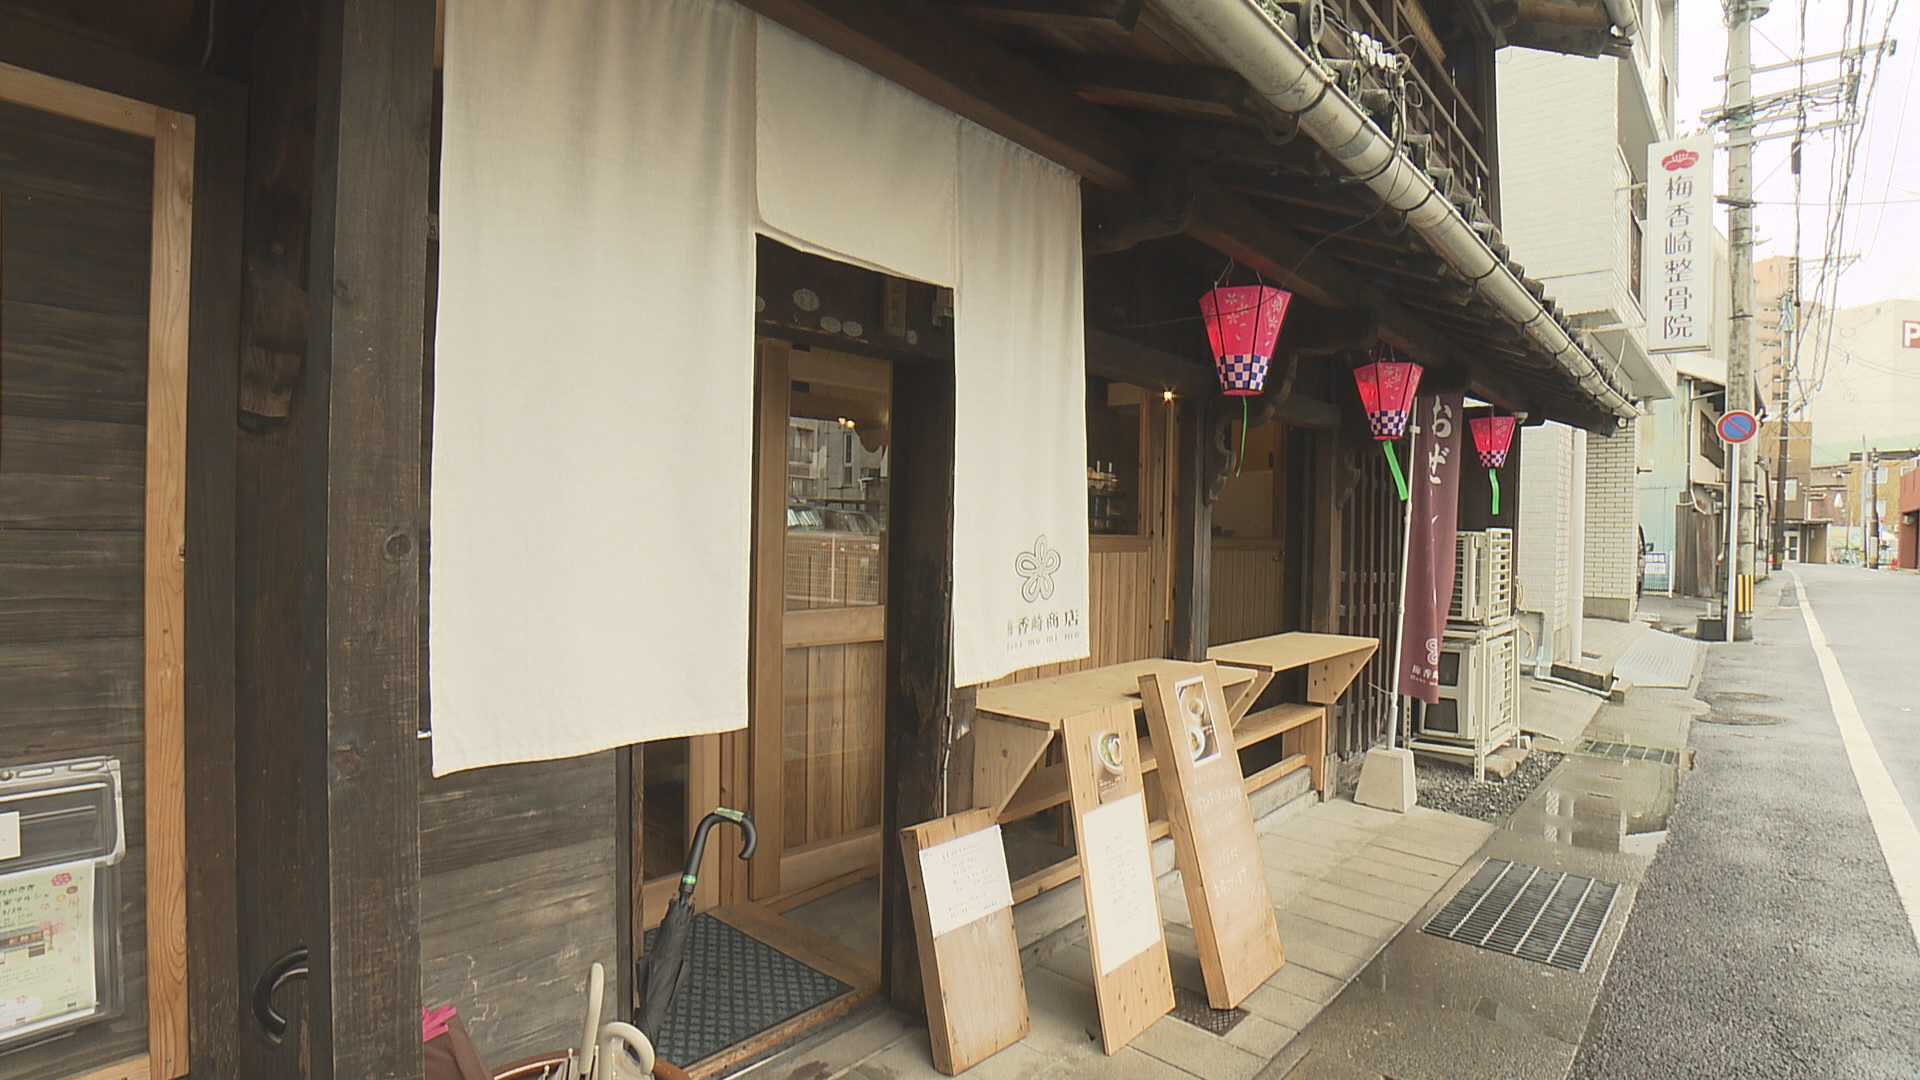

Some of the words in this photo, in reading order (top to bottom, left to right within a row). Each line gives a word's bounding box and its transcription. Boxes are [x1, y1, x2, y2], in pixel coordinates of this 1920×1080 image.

[1664, 175, 1695, 340] 梅香崎整骨院
[1904, 322, 1920, 347] P
[1064, 632, 1079, 640] mo
